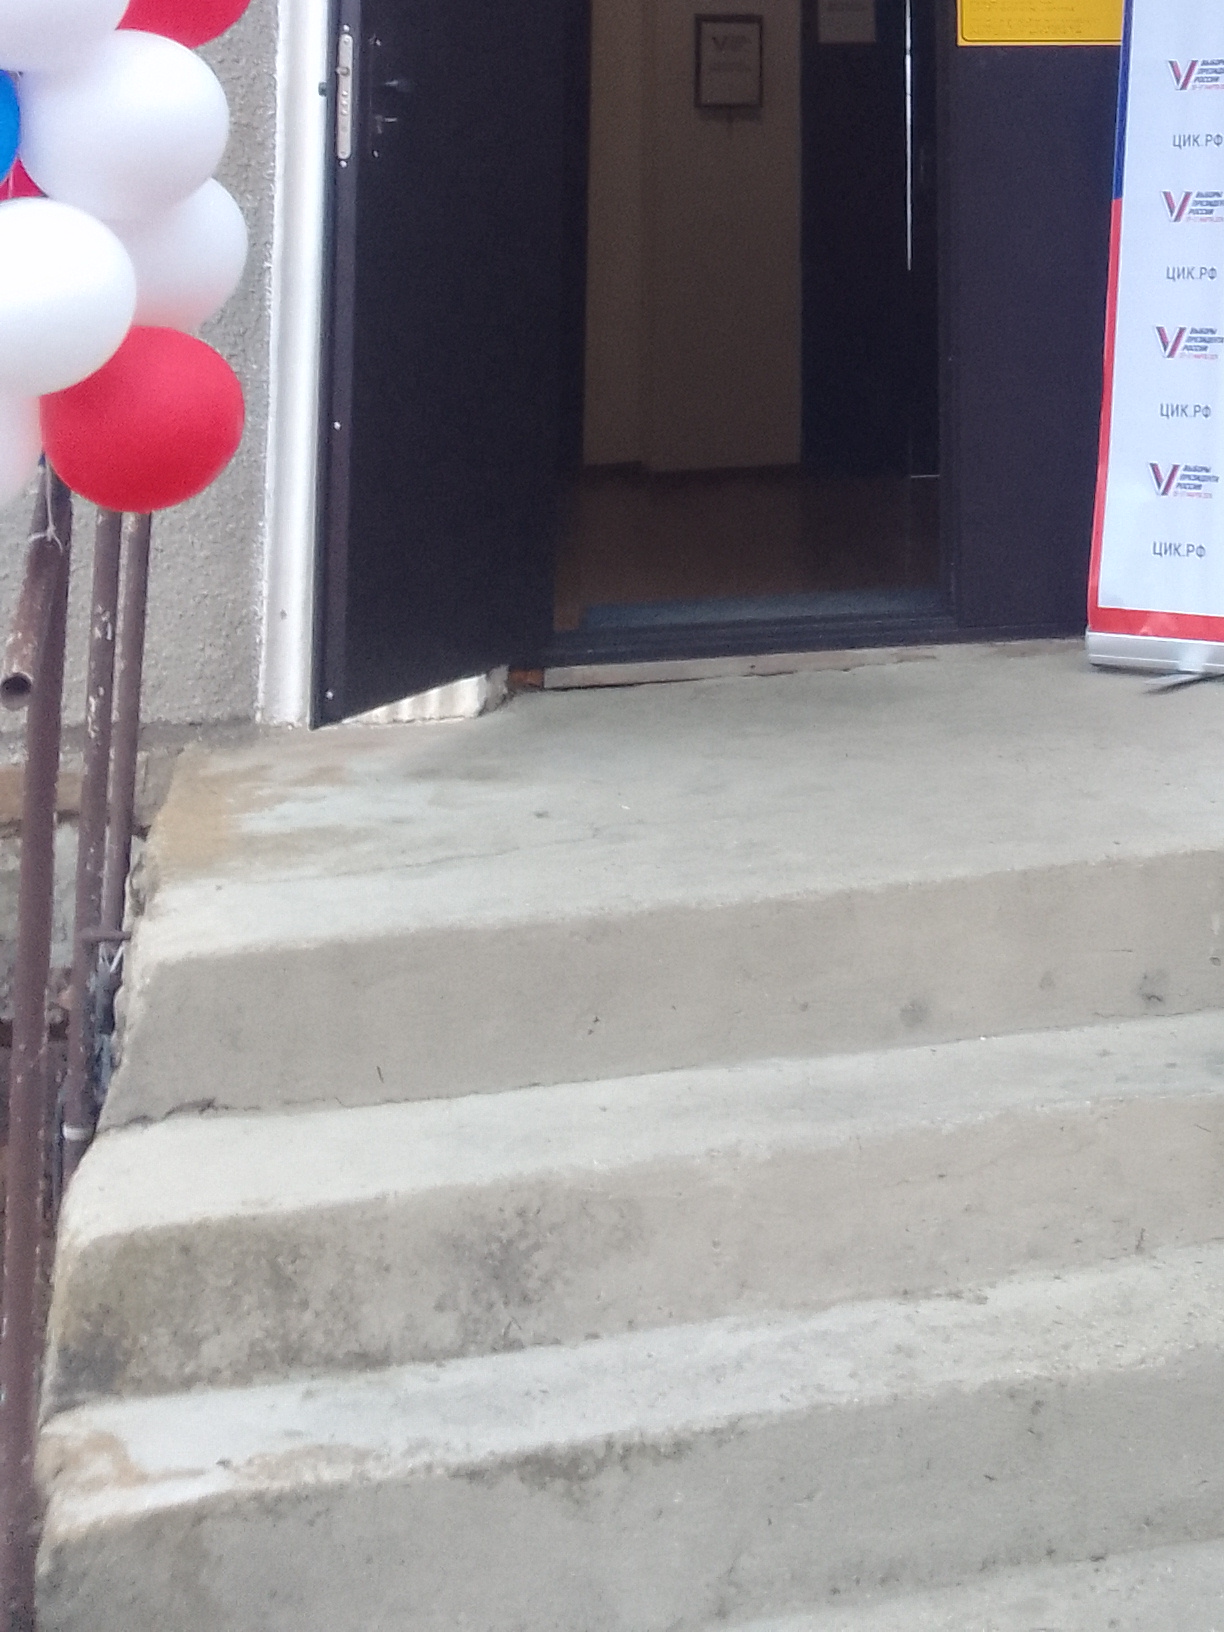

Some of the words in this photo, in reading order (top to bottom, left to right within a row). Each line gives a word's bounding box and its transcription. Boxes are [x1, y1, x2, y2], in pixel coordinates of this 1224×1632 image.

[1172, 133, 1223, 149] ЦИК.РФ
[1166, 266, 1217, 281] ЦИК.РФ
[1160, 403, 1211, 420] ЦИК.РФ
[1152, 541, 1206, 559] ЦИК.РФ
